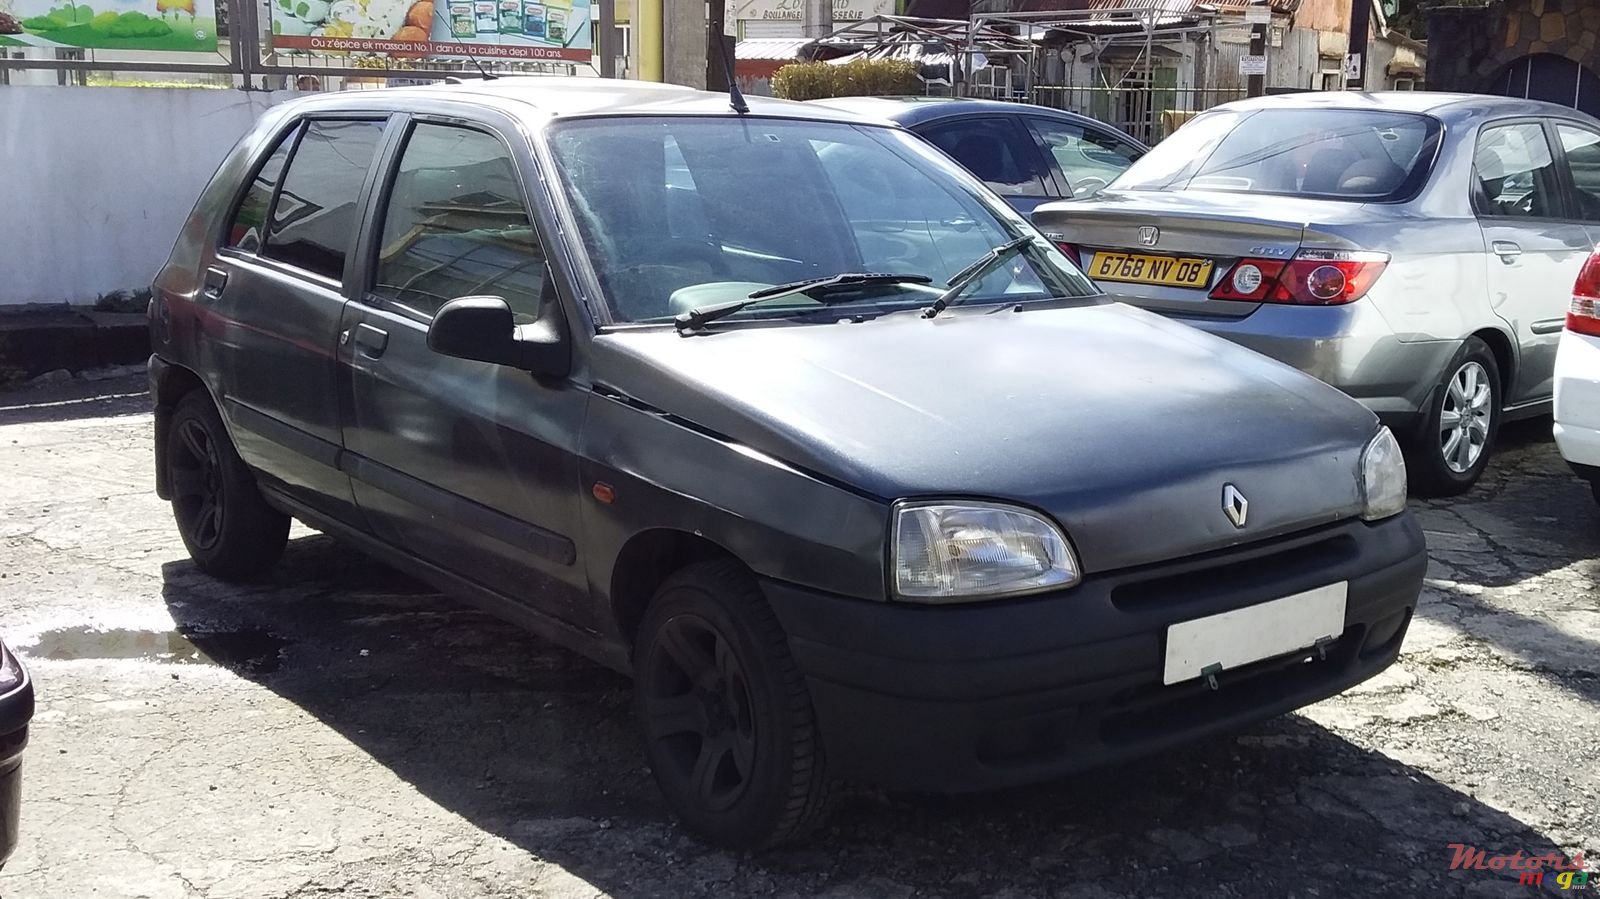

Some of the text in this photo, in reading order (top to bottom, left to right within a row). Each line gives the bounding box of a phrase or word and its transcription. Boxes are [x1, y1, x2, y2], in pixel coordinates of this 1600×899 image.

[763, 10, 863, 19] BOULANGE SSERIE
[311, 38, 325, 47] Ou
[362, 41, 373, 49] ek
[375, 42, 412, 51] massala
[436, 45, 453, 53] dan
[468, 46, 477, 54] la
[478, 46, 507, 56] cuisine
[509, 47, 528, 58] depi
[530, 48, 545, 57] 100
[546, 50, 563, 58] ans.
[1100, 256, 1202, 282] 6768 NV 08
